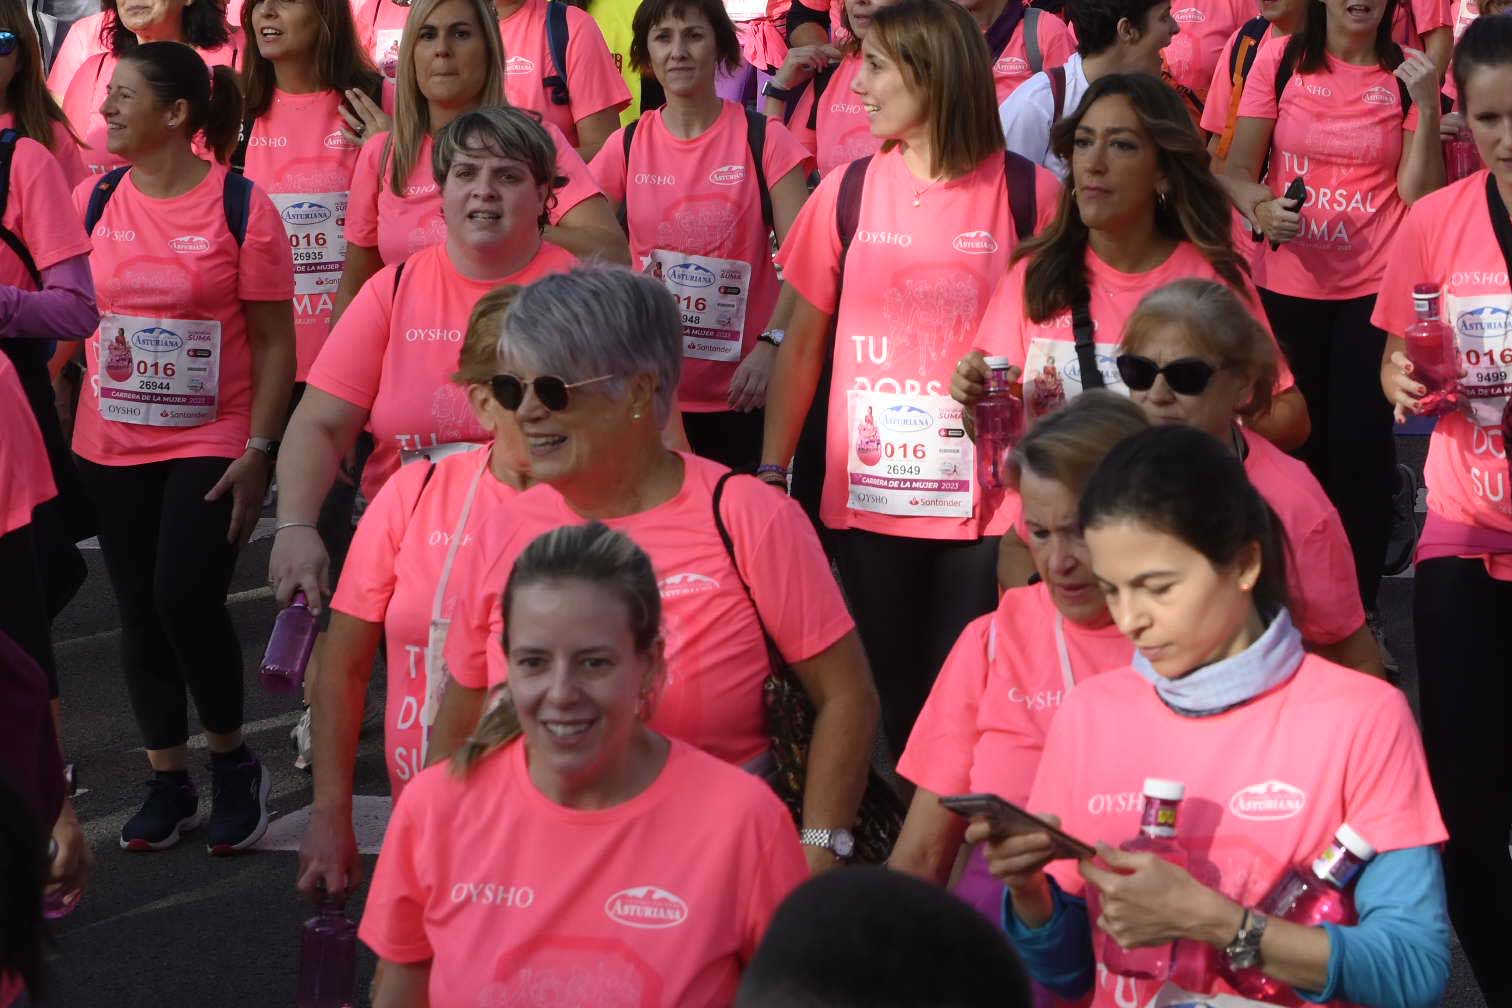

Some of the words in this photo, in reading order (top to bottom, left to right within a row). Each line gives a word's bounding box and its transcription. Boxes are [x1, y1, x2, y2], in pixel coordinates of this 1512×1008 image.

[1282, 151, 1309, 175] TU
[1284, 185, 1377, 213] ORSAL
[285, 210, 328, 221] ASTURIANA
[290, 232, 327, 248] 016
[858, 230, 913, 247] OYSHO
[293, 251, 324, 262] 26935
[296, 264, 307, 272] DE
[307, 264, 316, 272] LA
[1451, 272, 1508, 285] OYSHO
[293, 293, 334, 315] MA
[681, 314, 700, 325] 948
[405, 327, 462, 343] OYSHO
[852, 335, 888, 365] TU
[137, 360, 176, 378] 016
[1476, 371, 1507, 383] 9499
[139, 380, 171, 392] 26944
[108, 404, 141, 417] OYSHO
[884, 442, 927, 460] 016
[887, 464, 921, 476] 26949
[861, 476, 888, 487] CARRERA
[888, 479, 900, 488] DE
[900, 480, 911, 489] LA
[911, 480, 939, 490] MUJER
[1470, 467, 1504, 502] SU
[857, 493, 888, 505] OYSHO
[920, 498, 962, 507] Santander
[1088, 793, 1144, 815] OYSH
[450, 881, 534, 909] OYSHO
[611, 900, 682, 922] ASTURIANA
